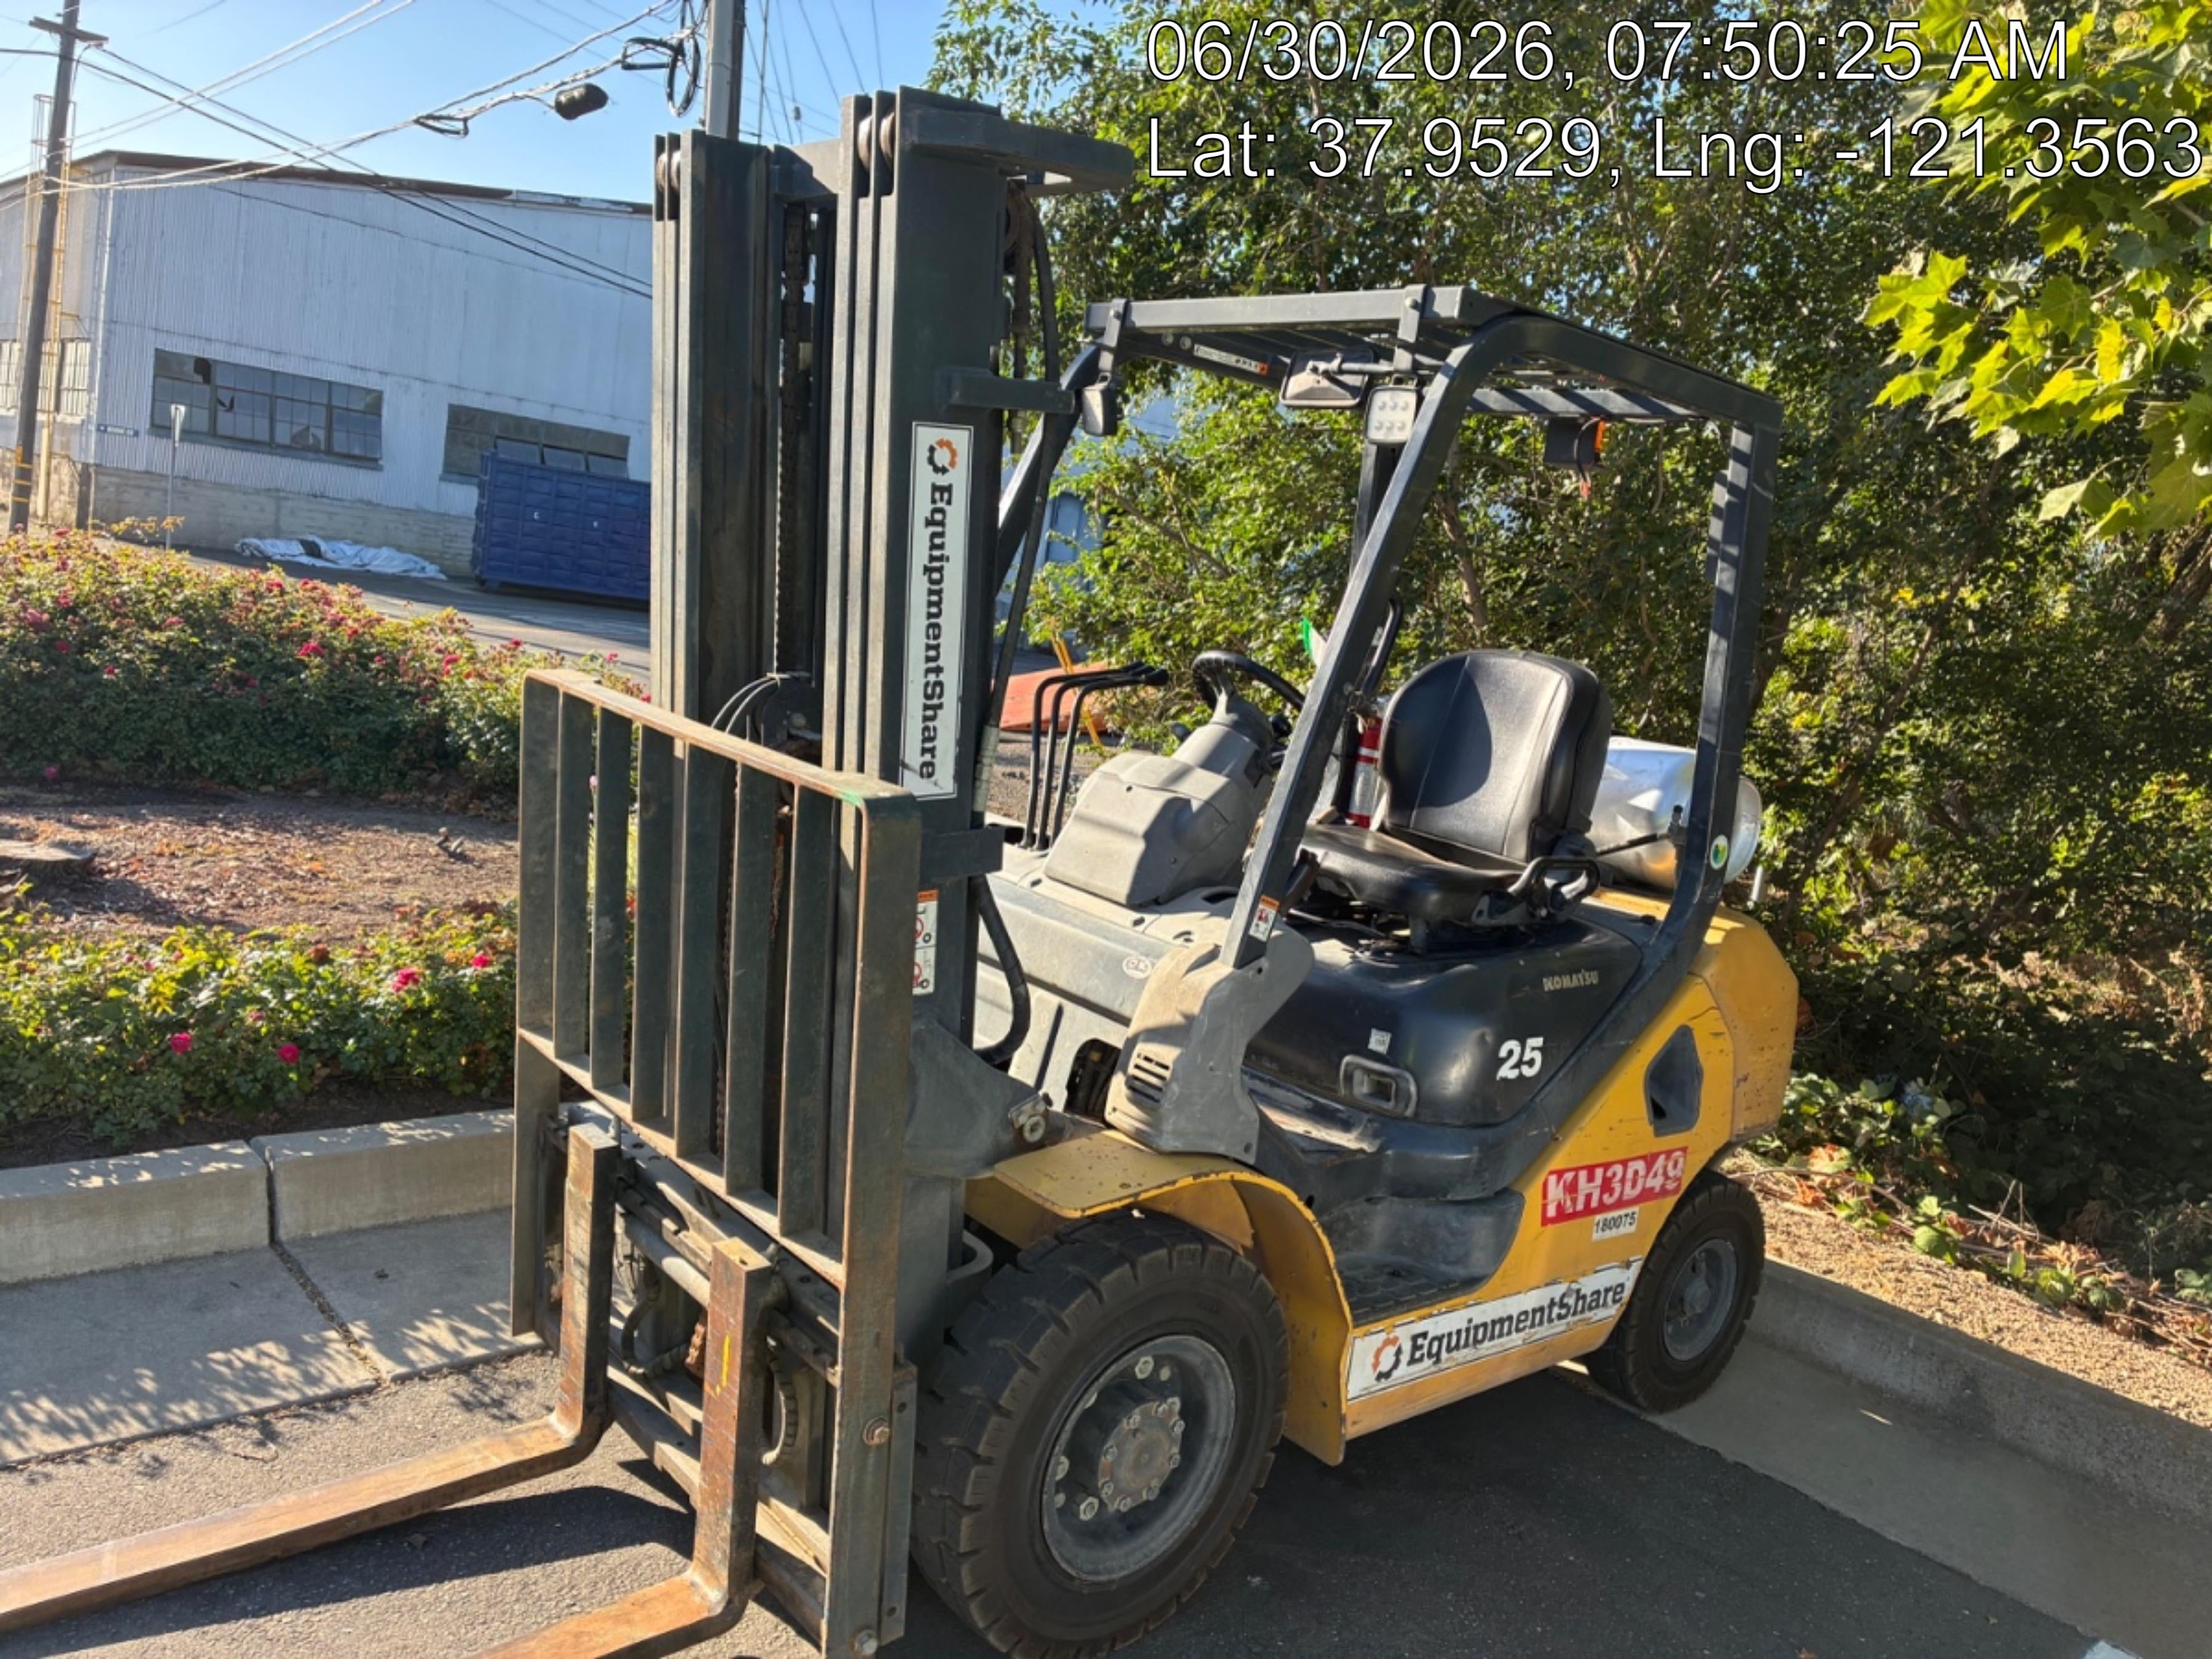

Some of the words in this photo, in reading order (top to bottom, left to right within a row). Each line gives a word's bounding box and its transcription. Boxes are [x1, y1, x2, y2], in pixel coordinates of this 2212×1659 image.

[919, 483, 953, 780] EquipmentShare
[1542, 969, 1599, 992] KOMATSU
[1496, 1037, 1543, 1081] 25
[1546, 1150, 1685, 1218] KH3D49
[1594, 1211, 1636, 1233] 180075
[1406, 1282, 1625, 1368] EquipmentShare
